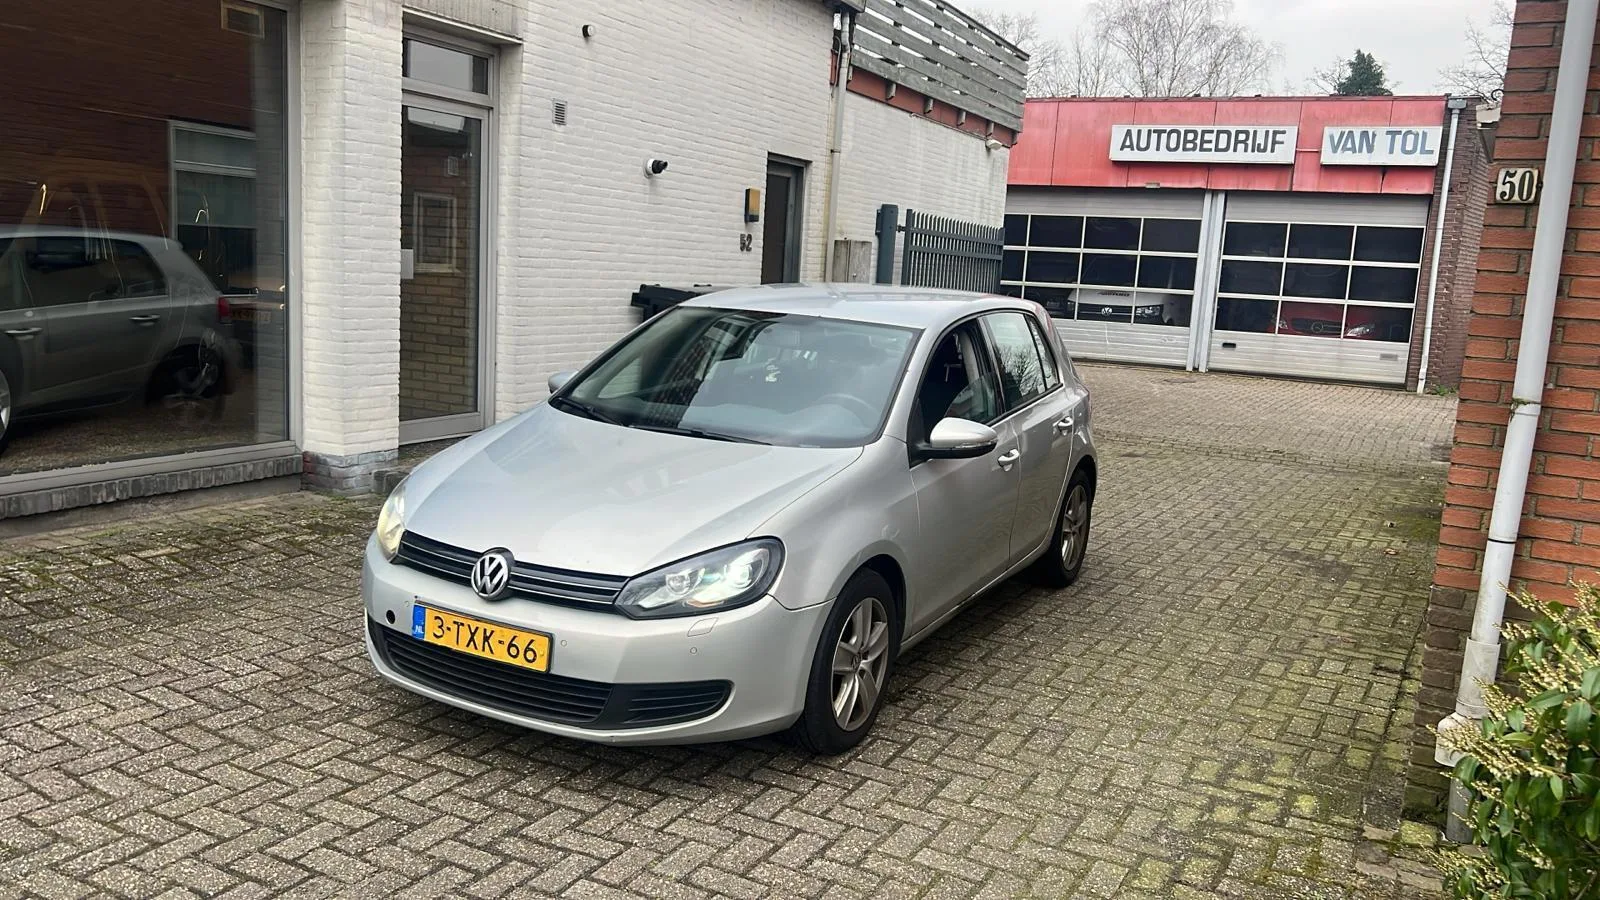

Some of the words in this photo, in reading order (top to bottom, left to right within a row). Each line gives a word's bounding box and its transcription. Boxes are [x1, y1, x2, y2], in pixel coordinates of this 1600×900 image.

[1119, 128, 1287, 154] AUTOBEDRIJF
[1329, 130, 1377, 154] VAN
[1385, 130, 1434, 155] TOL
[1500, 170, 1534, 201] 50
[740, 233, 752, 251] 52
[472, 554, 509, 597] VW
[414, 625, 424, 634] NL
[432, 615, 537, 664] 3-TXK-66
